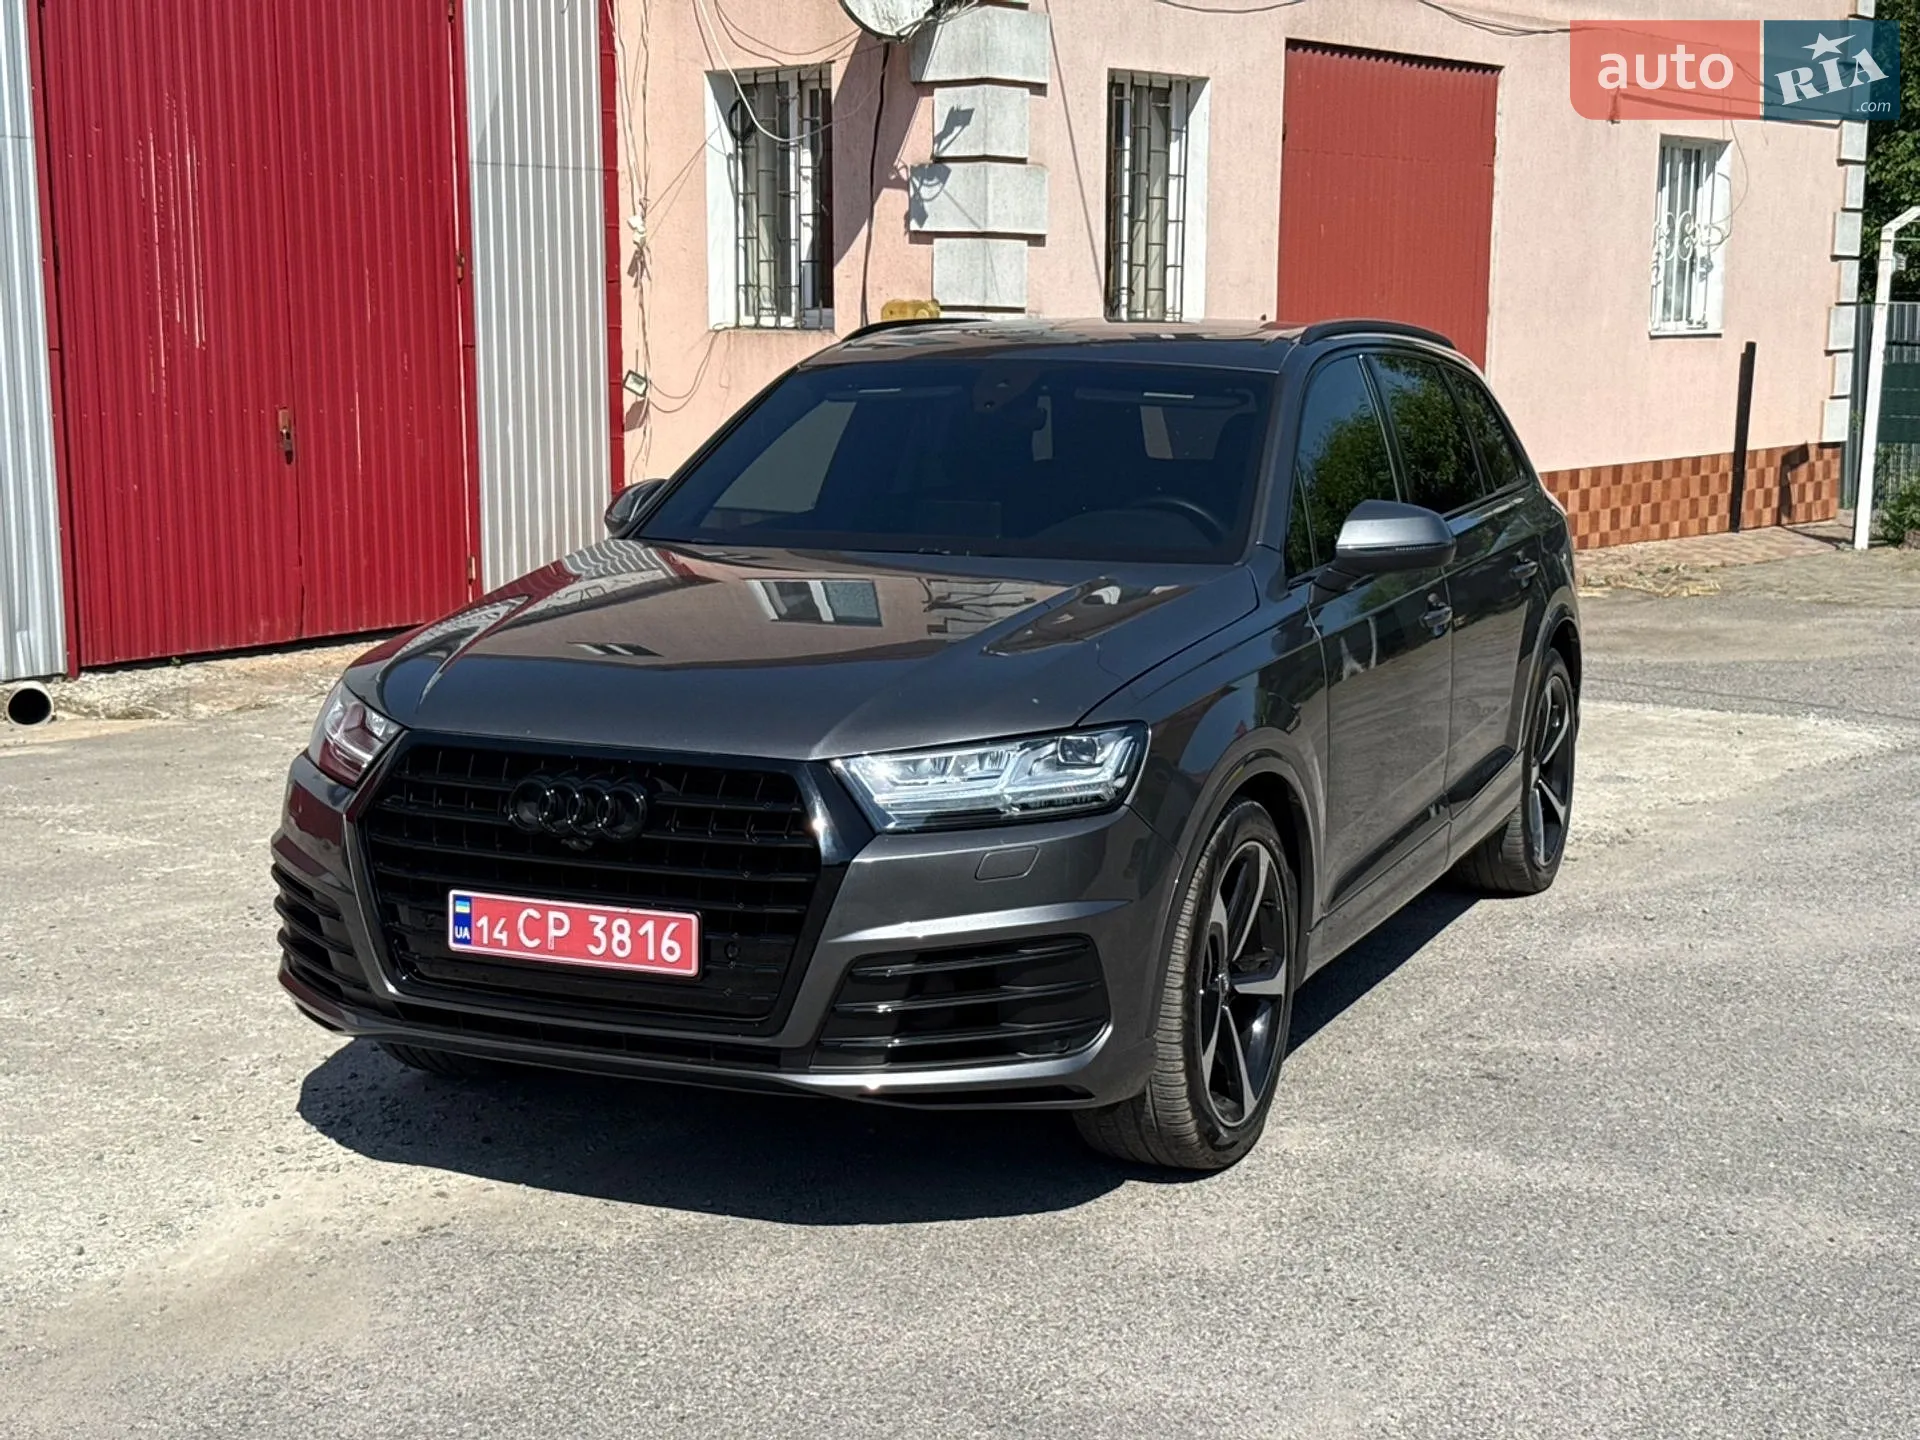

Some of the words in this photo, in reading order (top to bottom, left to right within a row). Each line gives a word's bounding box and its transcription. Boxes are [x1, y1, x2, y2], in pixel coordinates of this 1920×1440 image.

[455, 927, 471, 940] UA
[476, 915, 508, 947] 14
[587, 914, 682, 963] 3816
